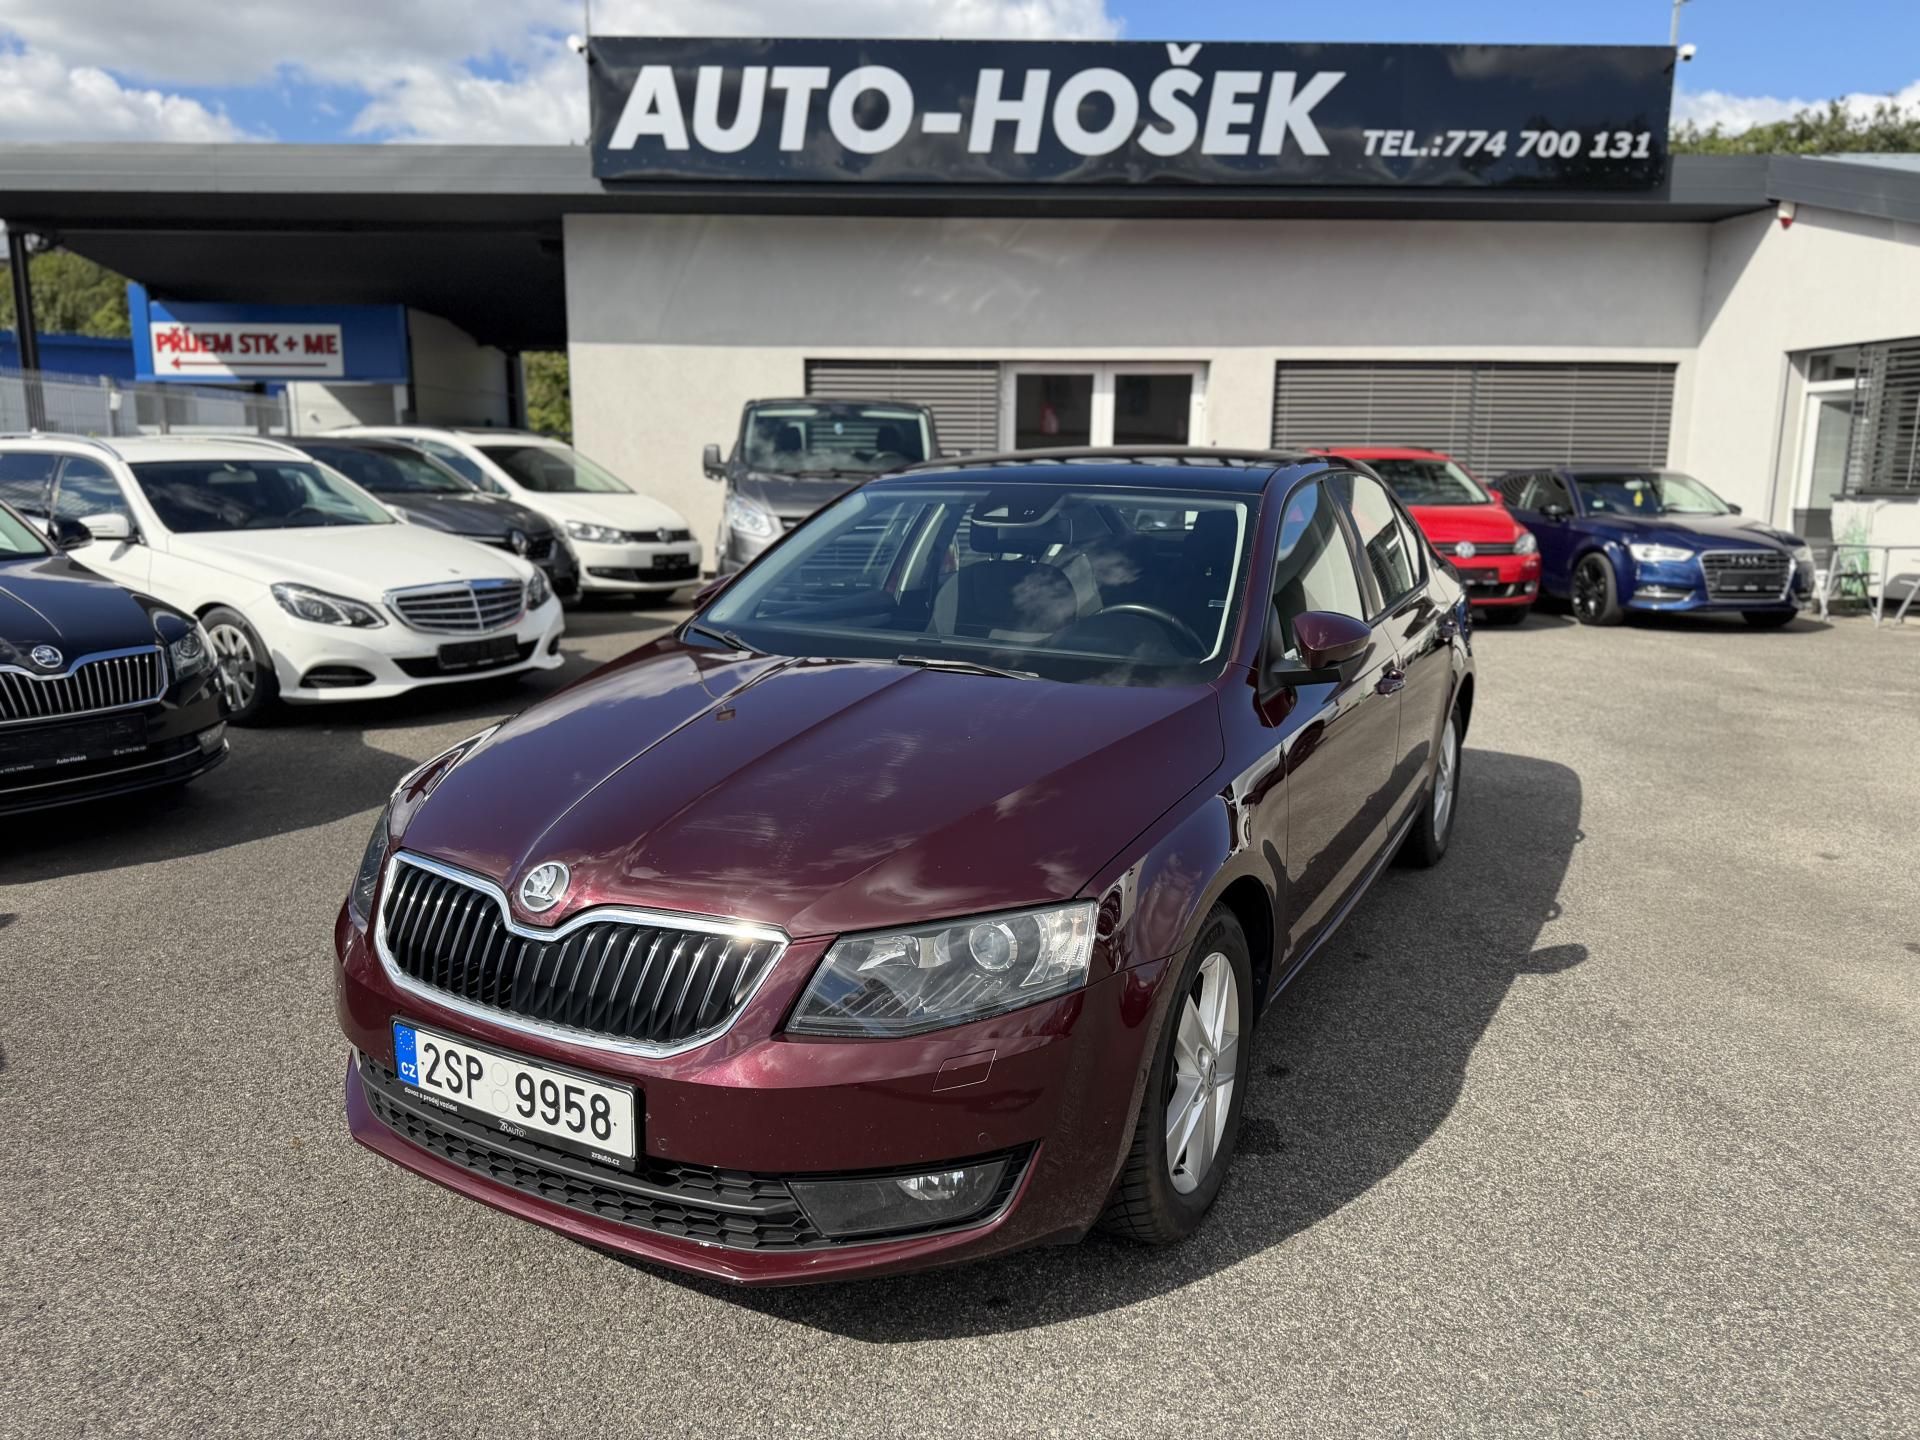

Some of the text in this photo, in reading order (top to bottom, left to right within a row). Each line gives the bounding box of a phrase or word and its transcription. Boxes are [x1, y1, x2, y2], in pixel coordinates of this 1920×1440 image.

[608, 43, 1346, 157] AUTO-HOŠEK
[1362, 129, 1651, 159] TEL.:774 700 131
[156, 327, 232, 353] PŘÍJEM
[239, 333, 279, 354] STK
[303, 334, 338, 355] ME
[401, 1061, 417, 1079] CZ
[423, 1042, 612, 1141] 2SP 9958
[591, 1151, 620, 1166] zrauto.cz
